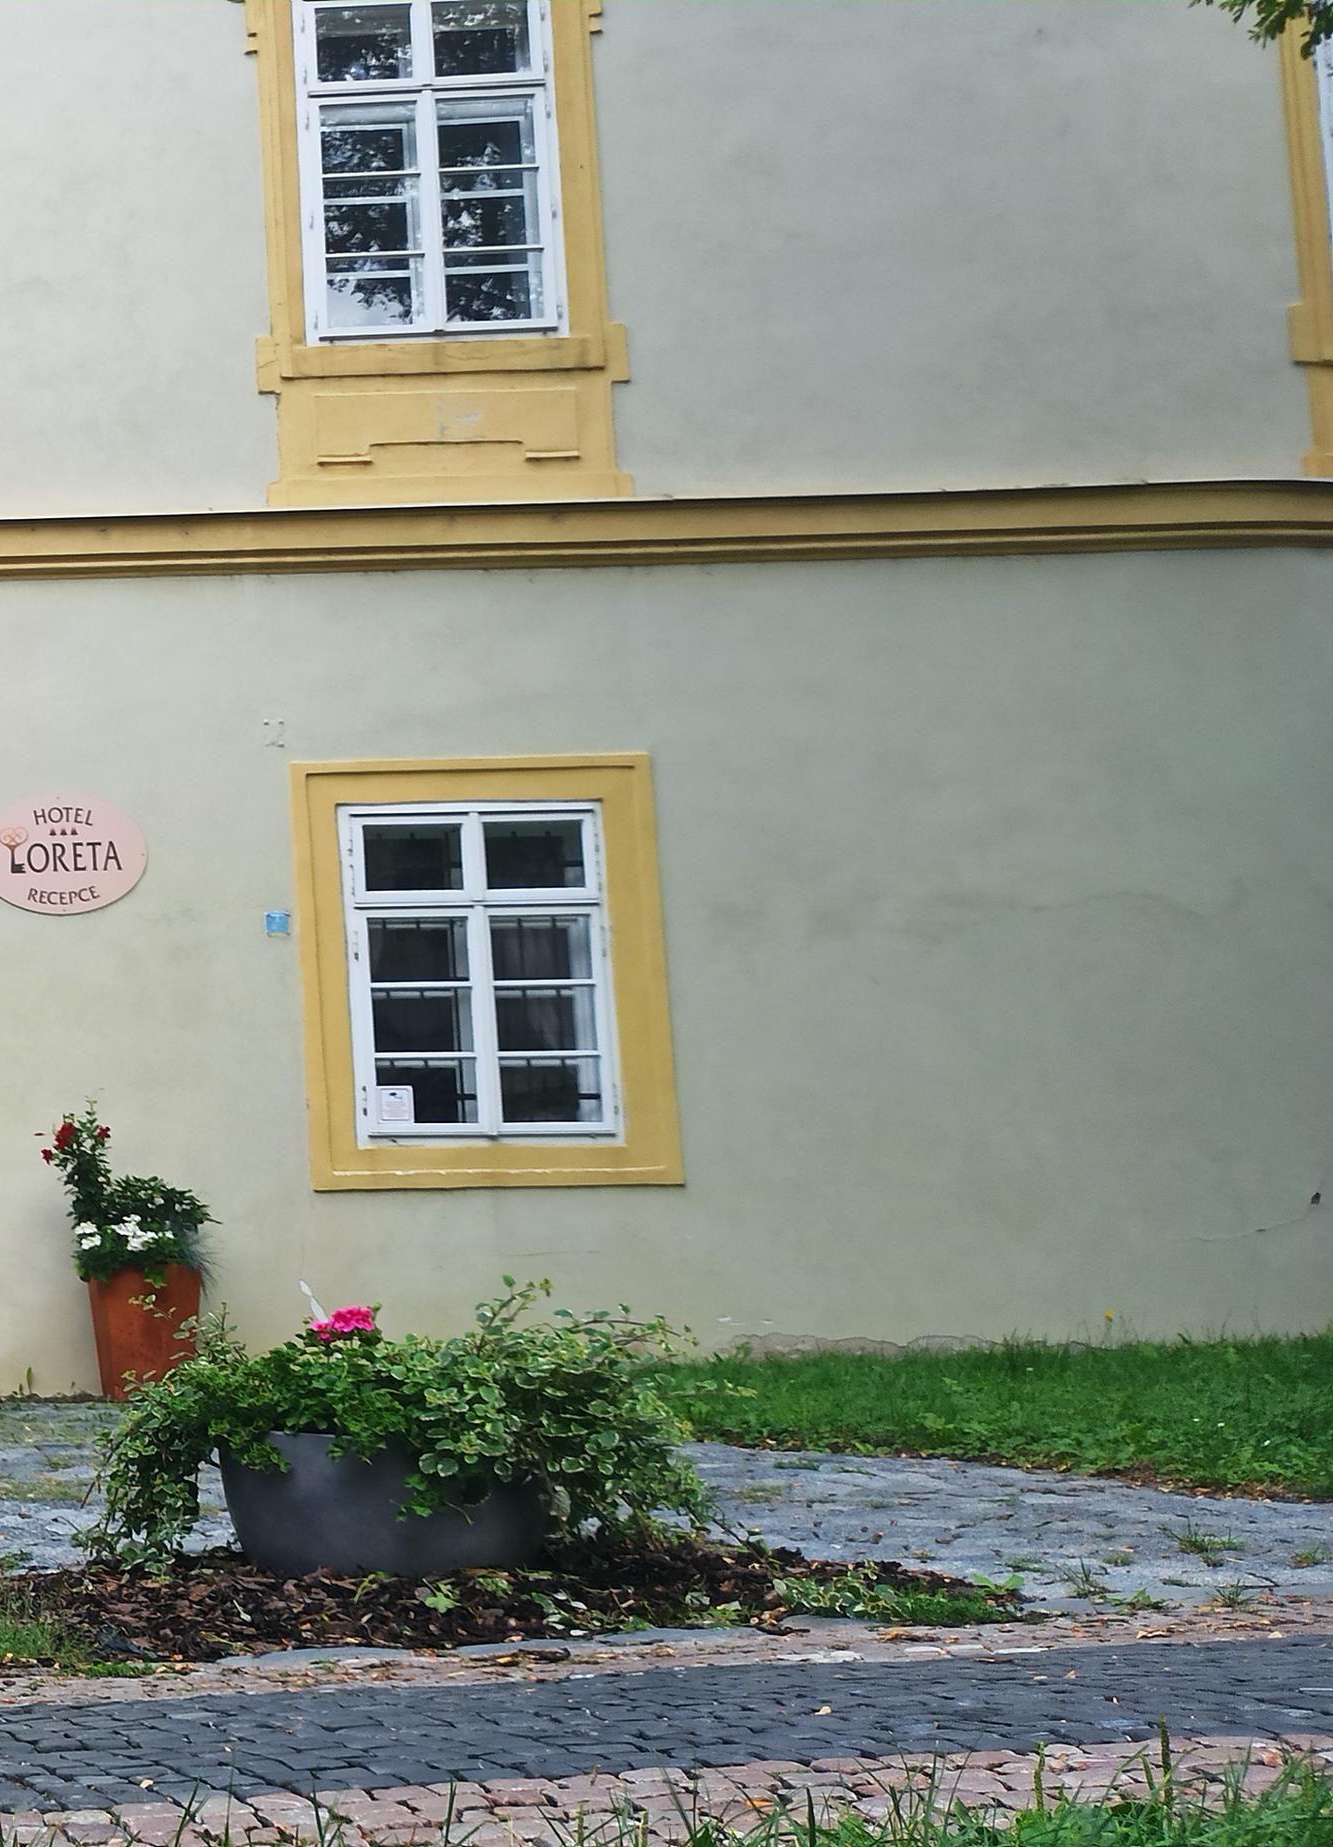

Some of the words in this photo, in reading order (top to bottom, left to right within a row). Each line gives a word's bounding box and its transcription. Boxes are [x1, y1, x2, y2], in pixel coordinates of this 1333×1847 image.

[33, 807, 94, 826] HOTEL
[10, 841, 123, 874] LORETA
[27, 885, 101, 905] RECEPCE
